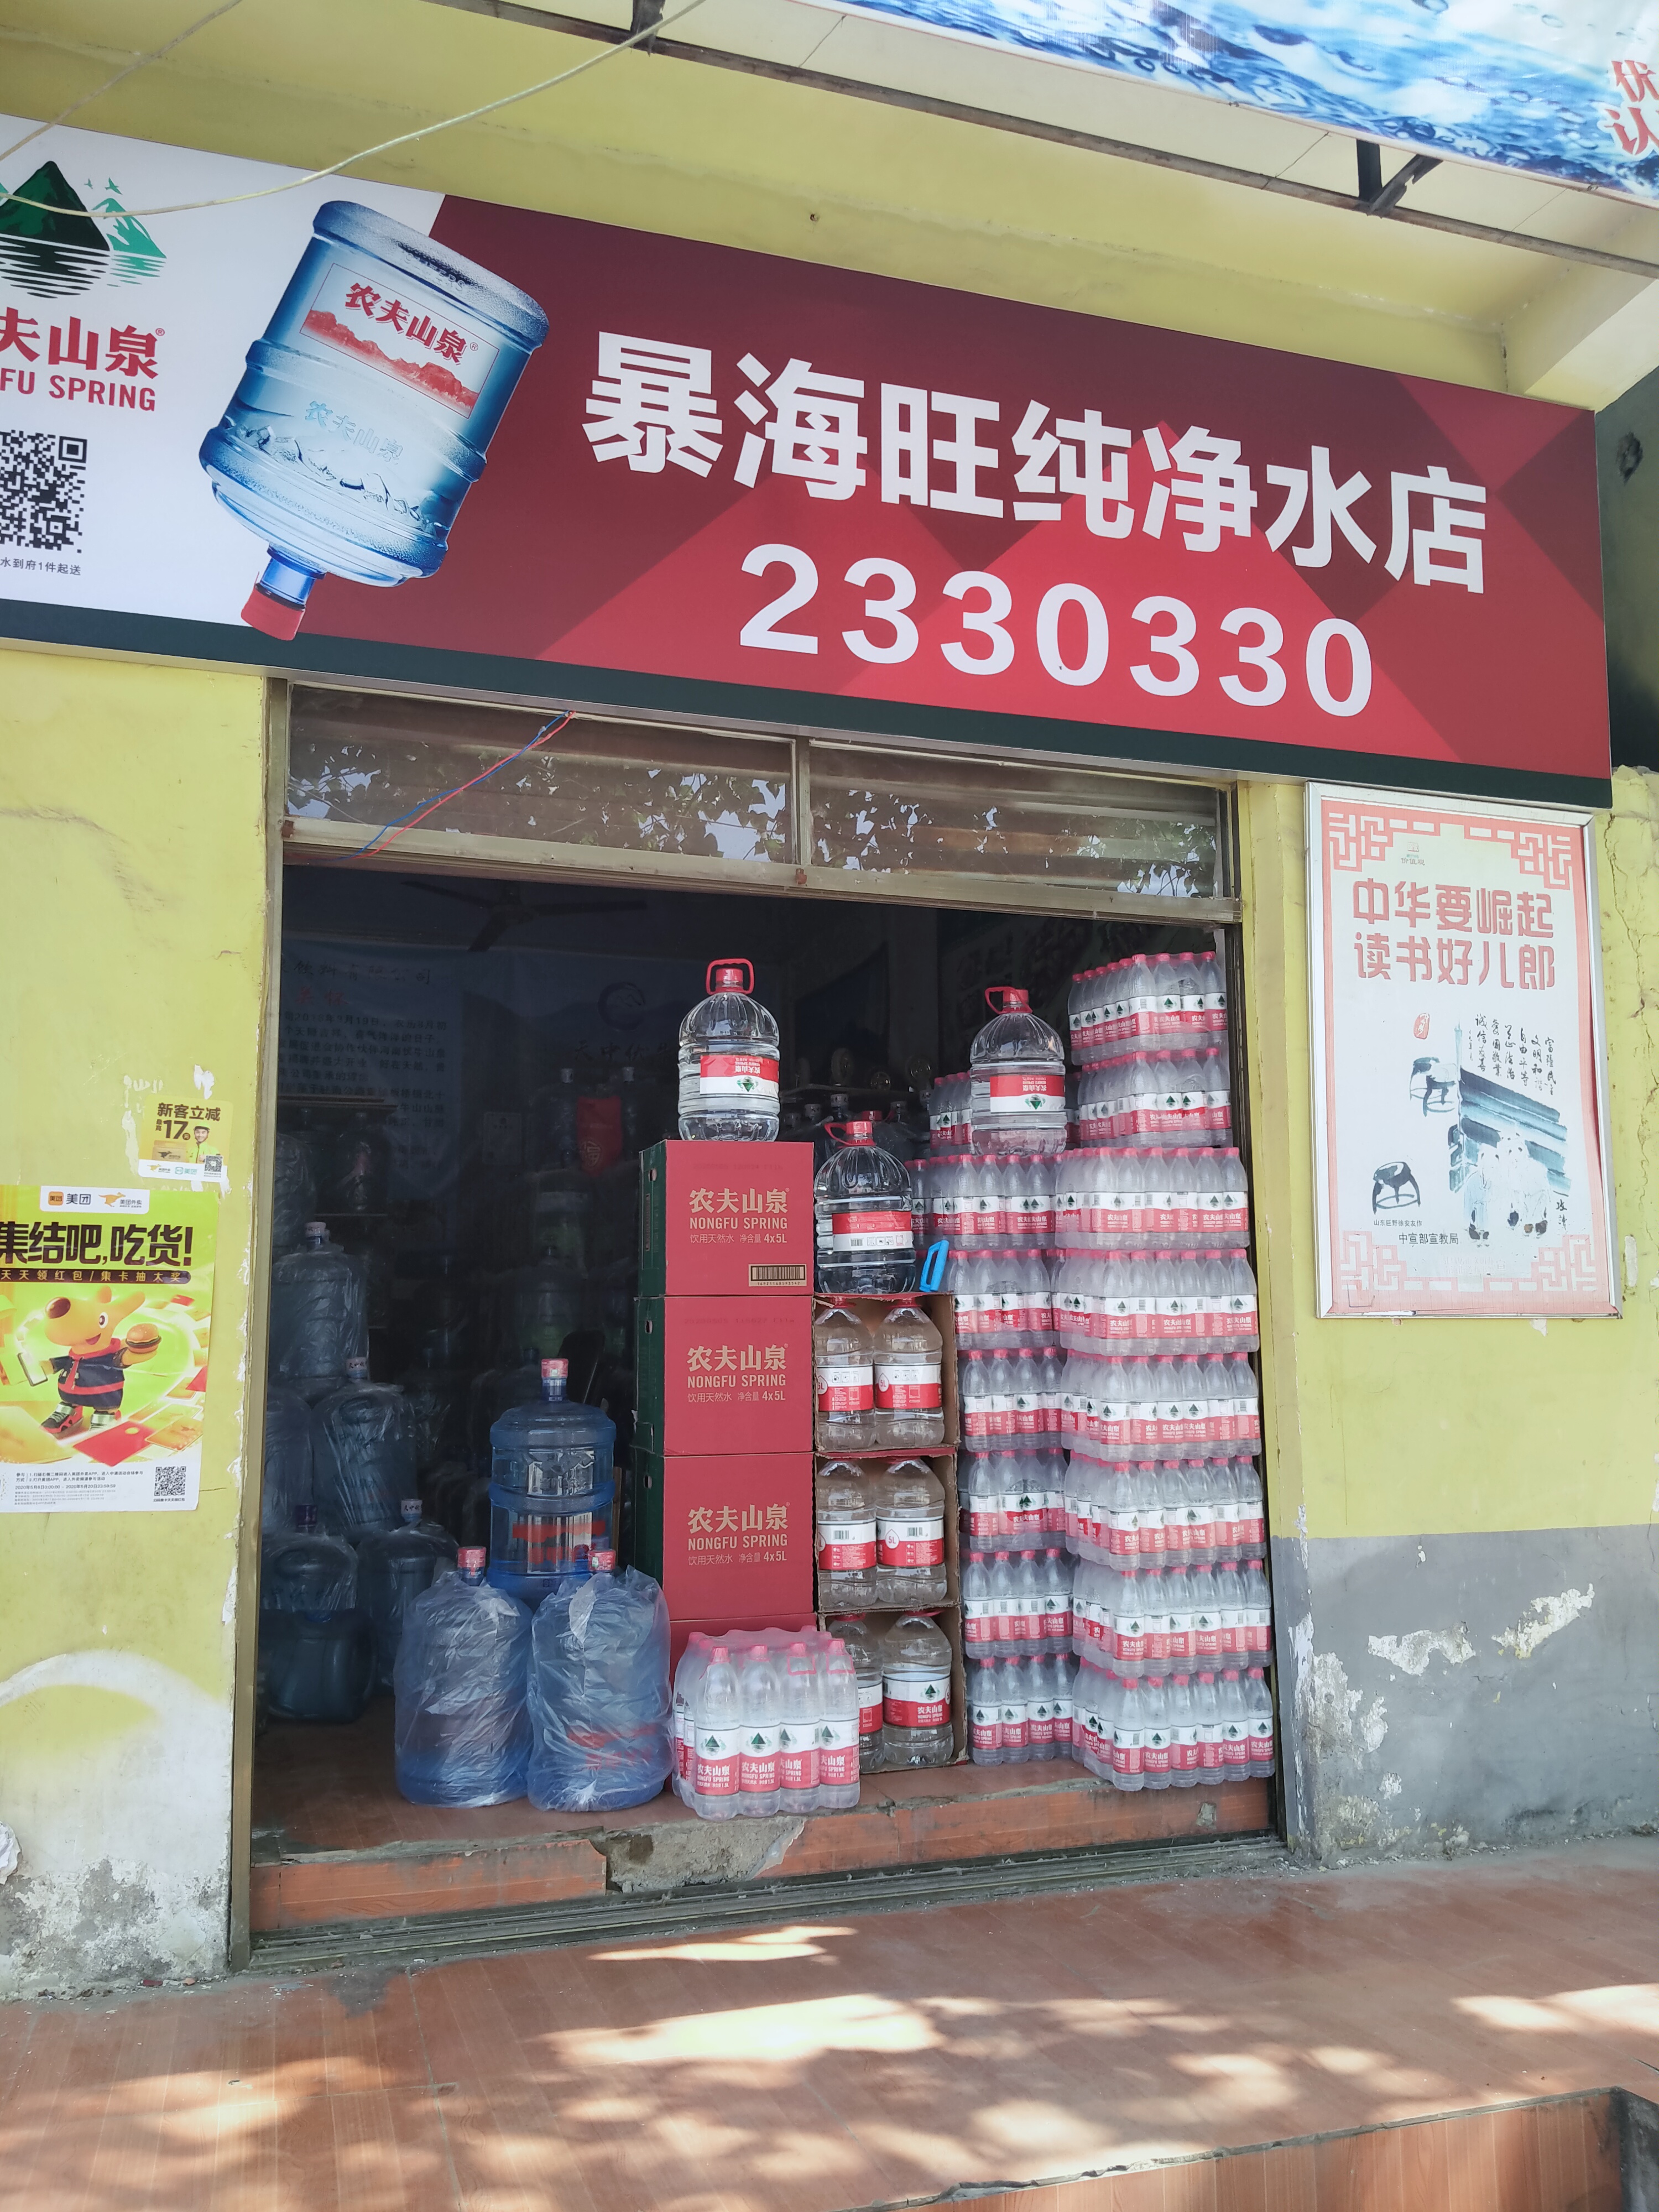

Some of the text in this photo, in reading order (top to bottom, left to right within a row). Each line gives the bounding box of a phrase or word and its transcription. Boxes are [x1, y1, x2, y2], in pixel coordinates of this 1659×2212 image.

[345, 282, 468, 365] 农夫山泉
[49, 375, 155, 412] SPRING
[582, 331, 1486, 594] 暴海旺纯净水店
[0, 556, 81, 576] 水到府1件起送
[739, 544, 1372, 717] 2330330
[1352, 878, 1554, 939] 中华要崛起
[1353, 931, 1556, 990] 读书好儿郎
[157, 1102, 221, 1121] 新客立减
[163, 1120, 189, 1139] 17
[66, 1193, 91, 1205] 美团
[688, 1187, 788, 1213] 农夫山泉
[690, 1217, 788, 1229] NONGFU SPRING
[1373, 1219, 1423, 1227] 山东巨野徐安友作
[690, 1233, 787, 1244] 饮用天然水 净含量 4x5L
[1399, 1232, 1459, 1245] 中宣部宣教局
[686, 1344, 787, 1371] 农夫山泉
[687, 1374, 786, 1389] NONGFU SPRING
[880, 1379, 886, 1387] 5L
[687, 1390, 786, 1403] 饮用天然水 净含量 4x5L
[687, 1503, 789, 1533] 农夫山泉
[687, 1533, 787, 1551] NONGFU SPRING
[888, 1536, 896, 1544] 5L
[687, 1551, 787, 1566] 饮用天然水 净含量 4x5L
[697, 1764, 731, 1776] 农夫山泉
[742, 1760, 775, 1773] 农夫山泉
